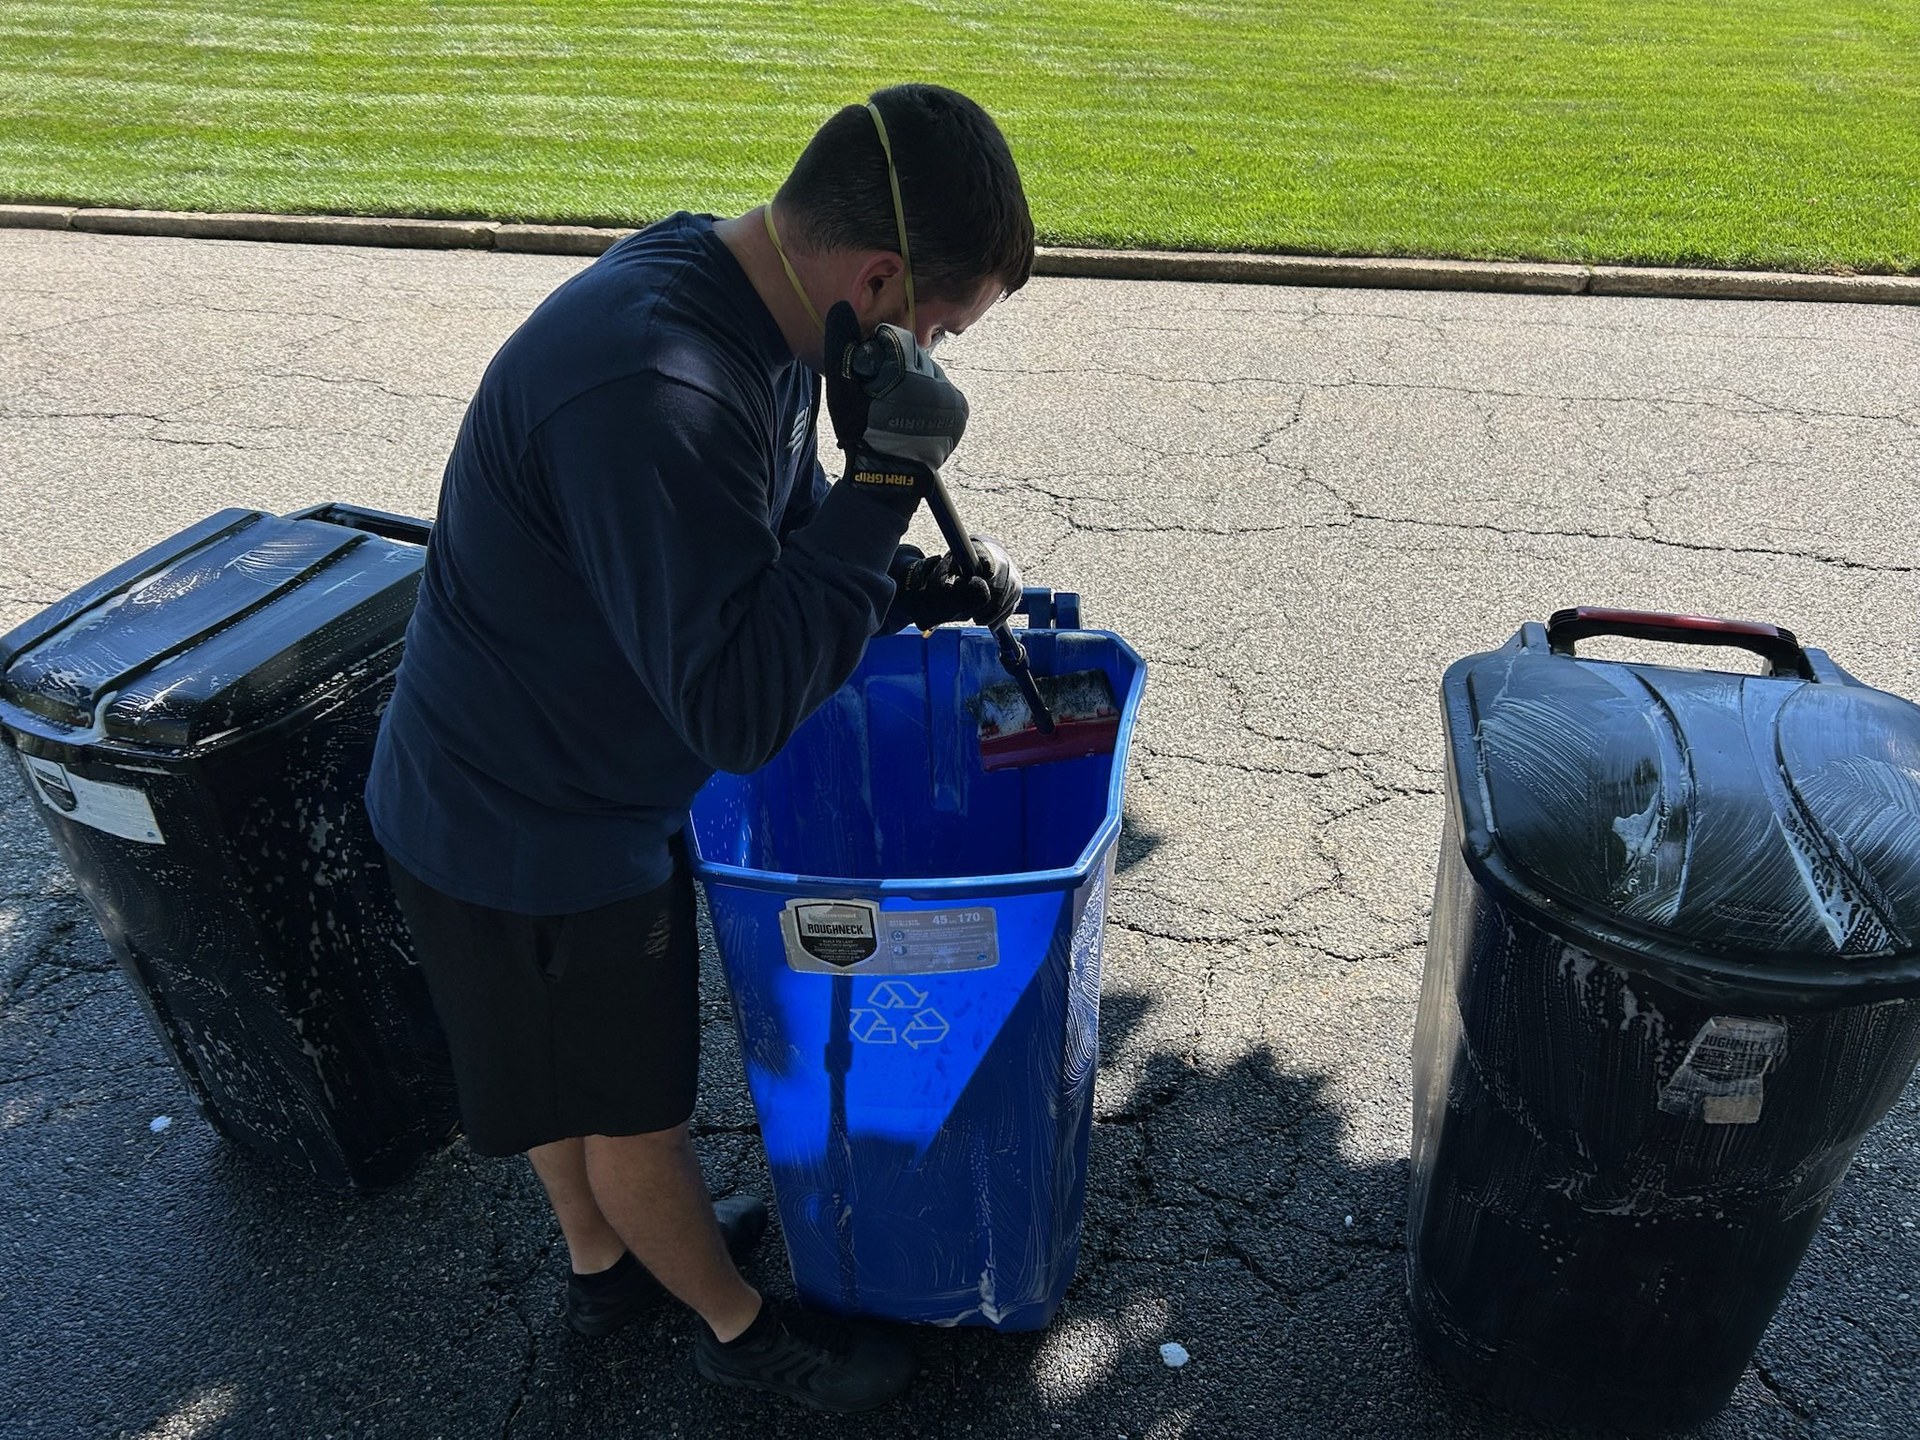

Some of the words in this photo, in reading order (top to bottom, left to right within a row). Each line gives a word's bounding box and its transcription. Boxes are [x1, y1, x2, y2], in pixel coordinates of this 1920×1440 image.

[854, 471, 884, 484] GRIP
[885, 473, 915, 486] FIRM
[932, 914, 948, 925] 45
[958, 912, 980, 923] 170
[807, 923, 864, 935] ROUGHNECK
